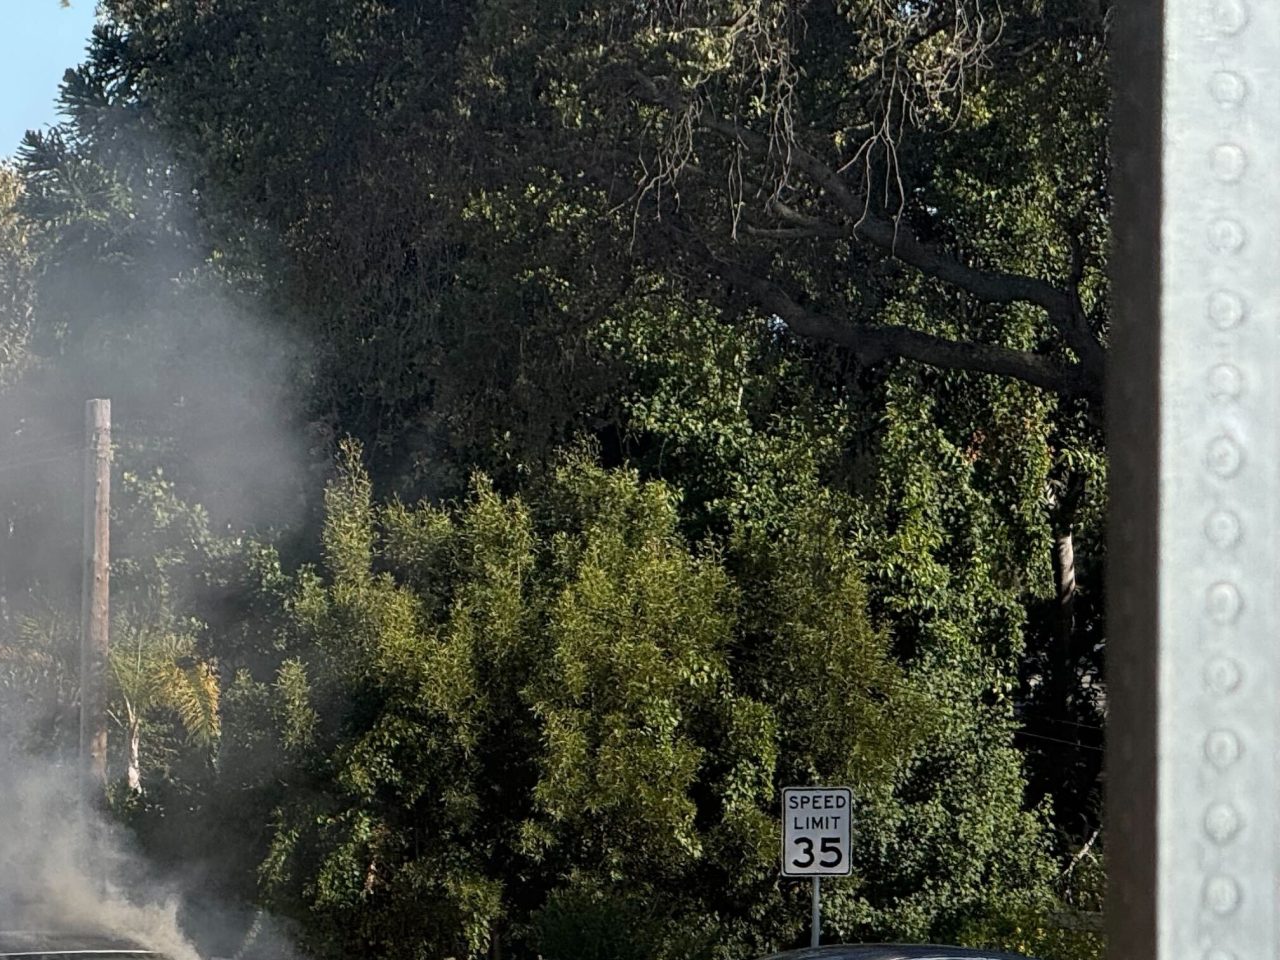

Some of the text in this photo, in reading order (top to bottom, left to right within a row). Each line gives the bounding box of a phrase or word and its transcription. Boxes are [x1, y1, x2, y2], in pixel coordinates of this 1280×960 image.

[789, 795, 846, 809] SPEED
[794, 816, 840, 830] LIMIT
[792, 837, 843, 868] 35
